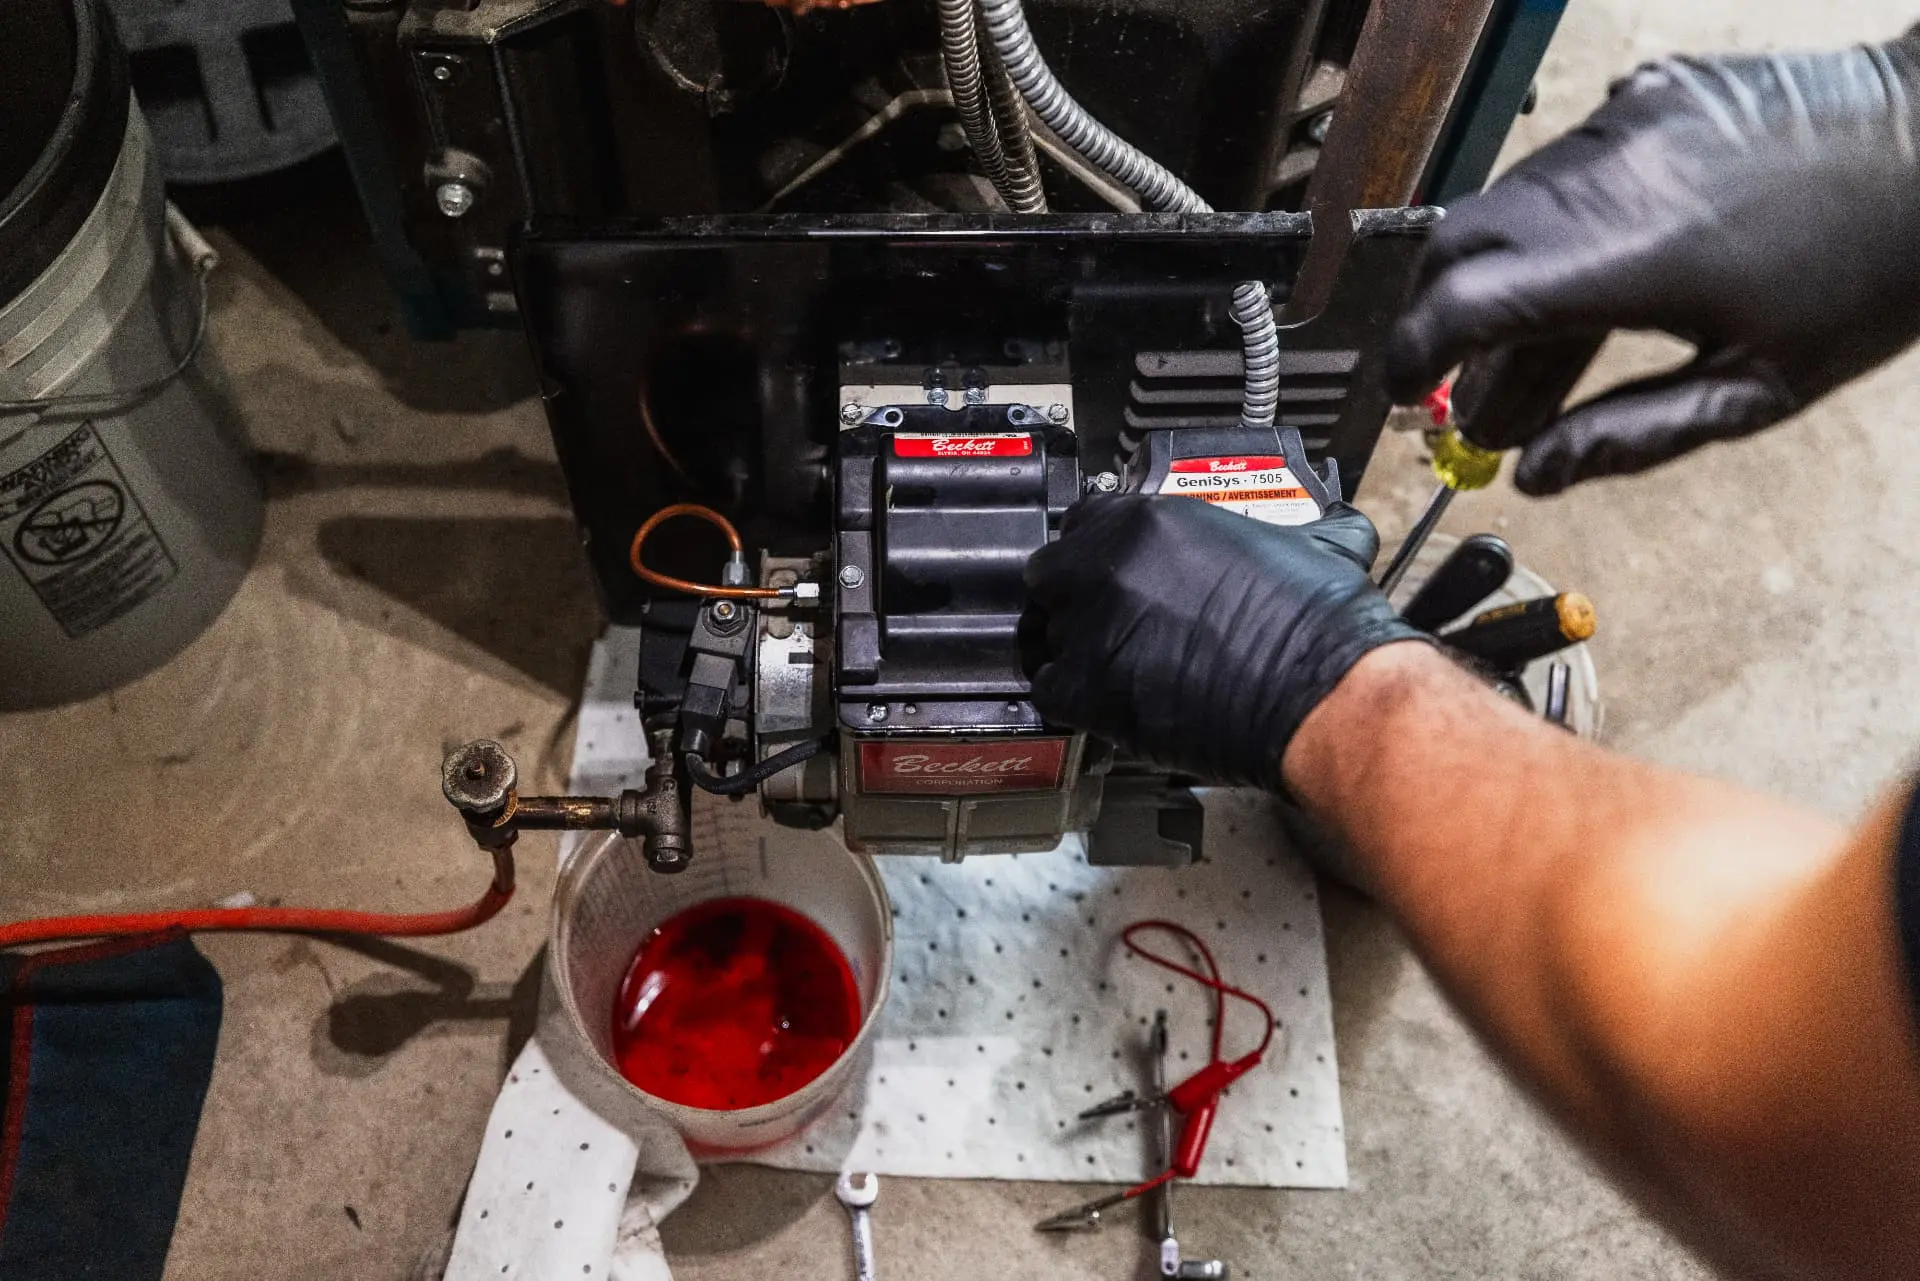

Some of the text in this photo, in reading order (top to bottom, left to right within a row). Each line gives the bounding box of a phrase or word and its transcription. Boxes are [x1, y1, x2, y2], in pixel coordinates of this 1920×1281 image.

[931, 438, 996, 451] Beckett
[1209, 460, 1248, 472] Beckett
[1176, 473, 1283, 489] GeniSys 7505
[1228, 489, 1298, 501] AVERTISSEMENT
[892, 754, 1034, 774] Beckett
[915, 778, 1004, 787] CORPORATION
